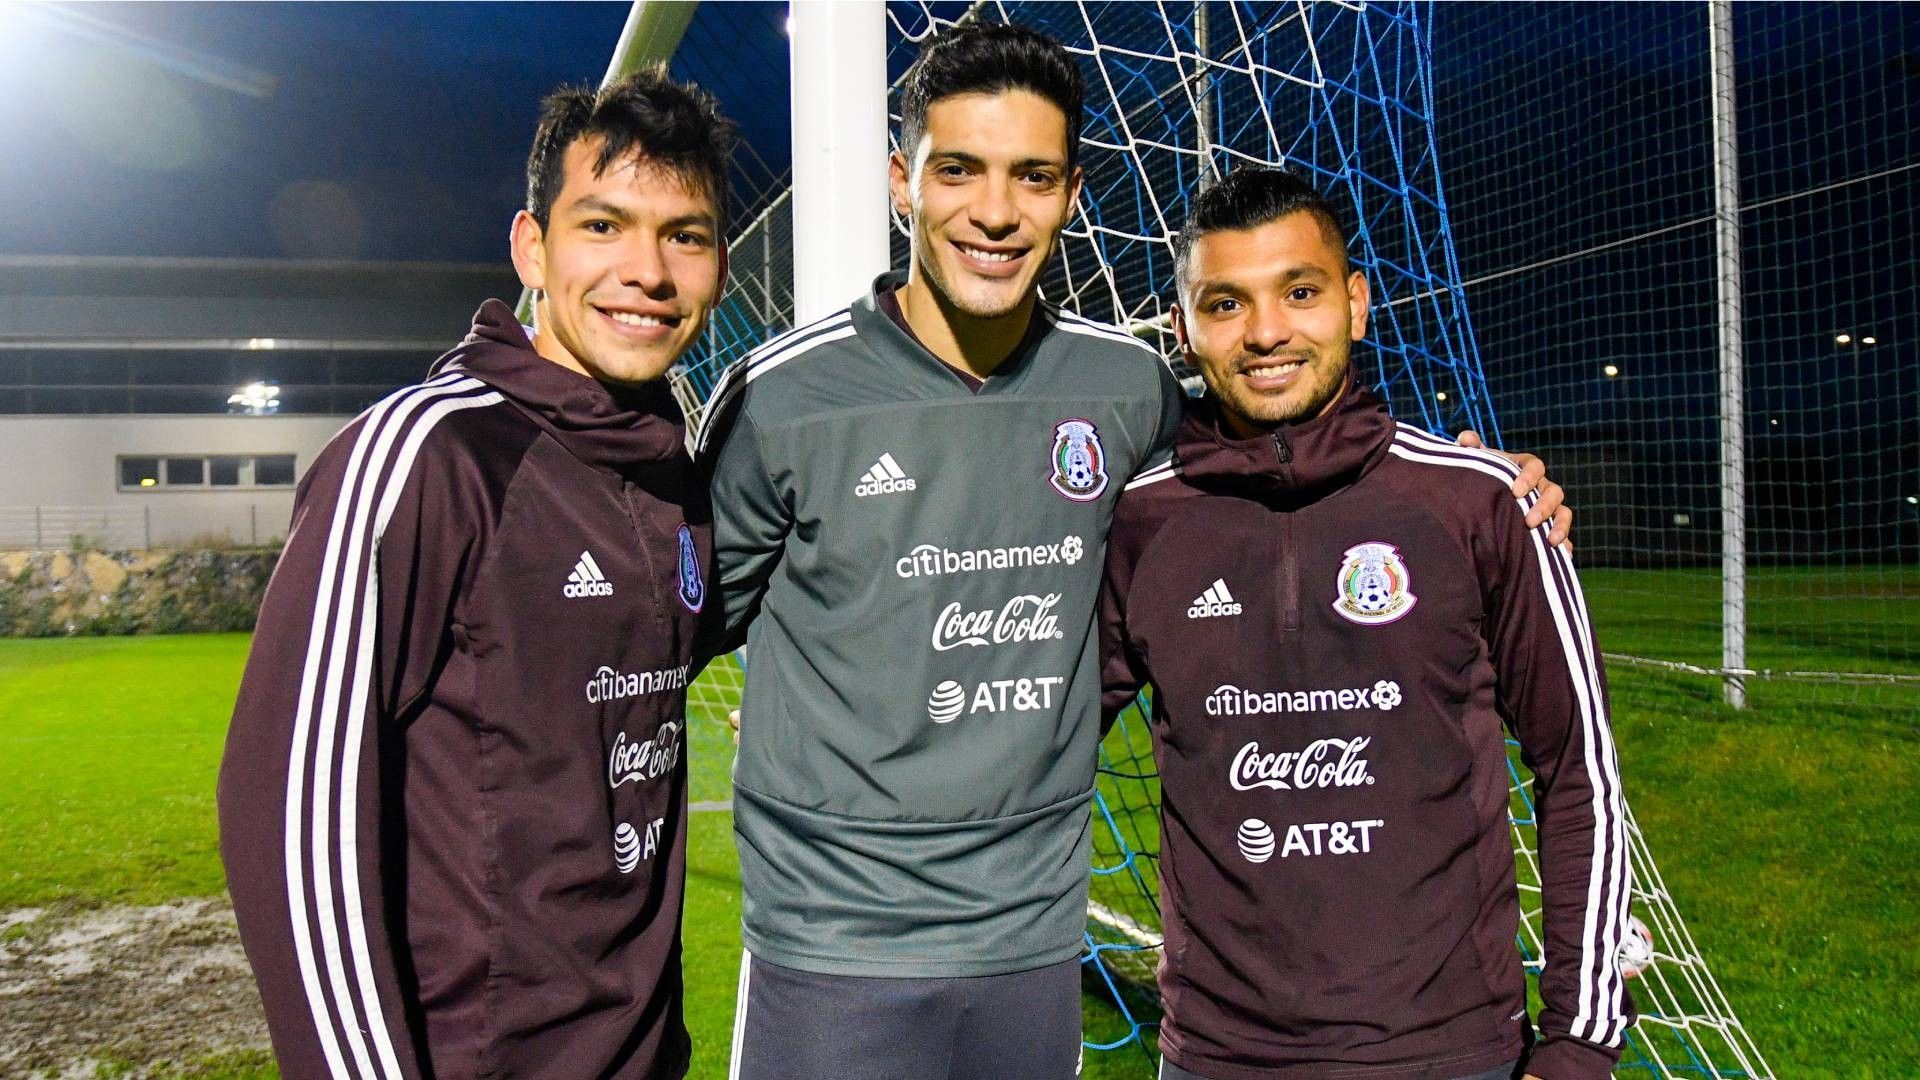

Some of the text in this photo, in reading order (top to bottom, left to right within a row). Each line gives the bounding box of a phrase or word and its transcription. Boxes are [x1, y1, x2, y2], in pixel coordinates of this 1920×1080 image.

[855, 477, 916, 497] adidas
[896, 544, 1060, 578] citibanamex
[563, 580, 614, 599] adidas
[1188, 602, 1243, 619] adidas
[586, 665, 689, 704] citibanamex
[970, 677, 1058, 714] AT&T
[1206, 685, 1371, 716] citibanamex
[1230, 736, 1372, 791] Coca-Cola
[1281, 820, 1378, 858] AT&T
